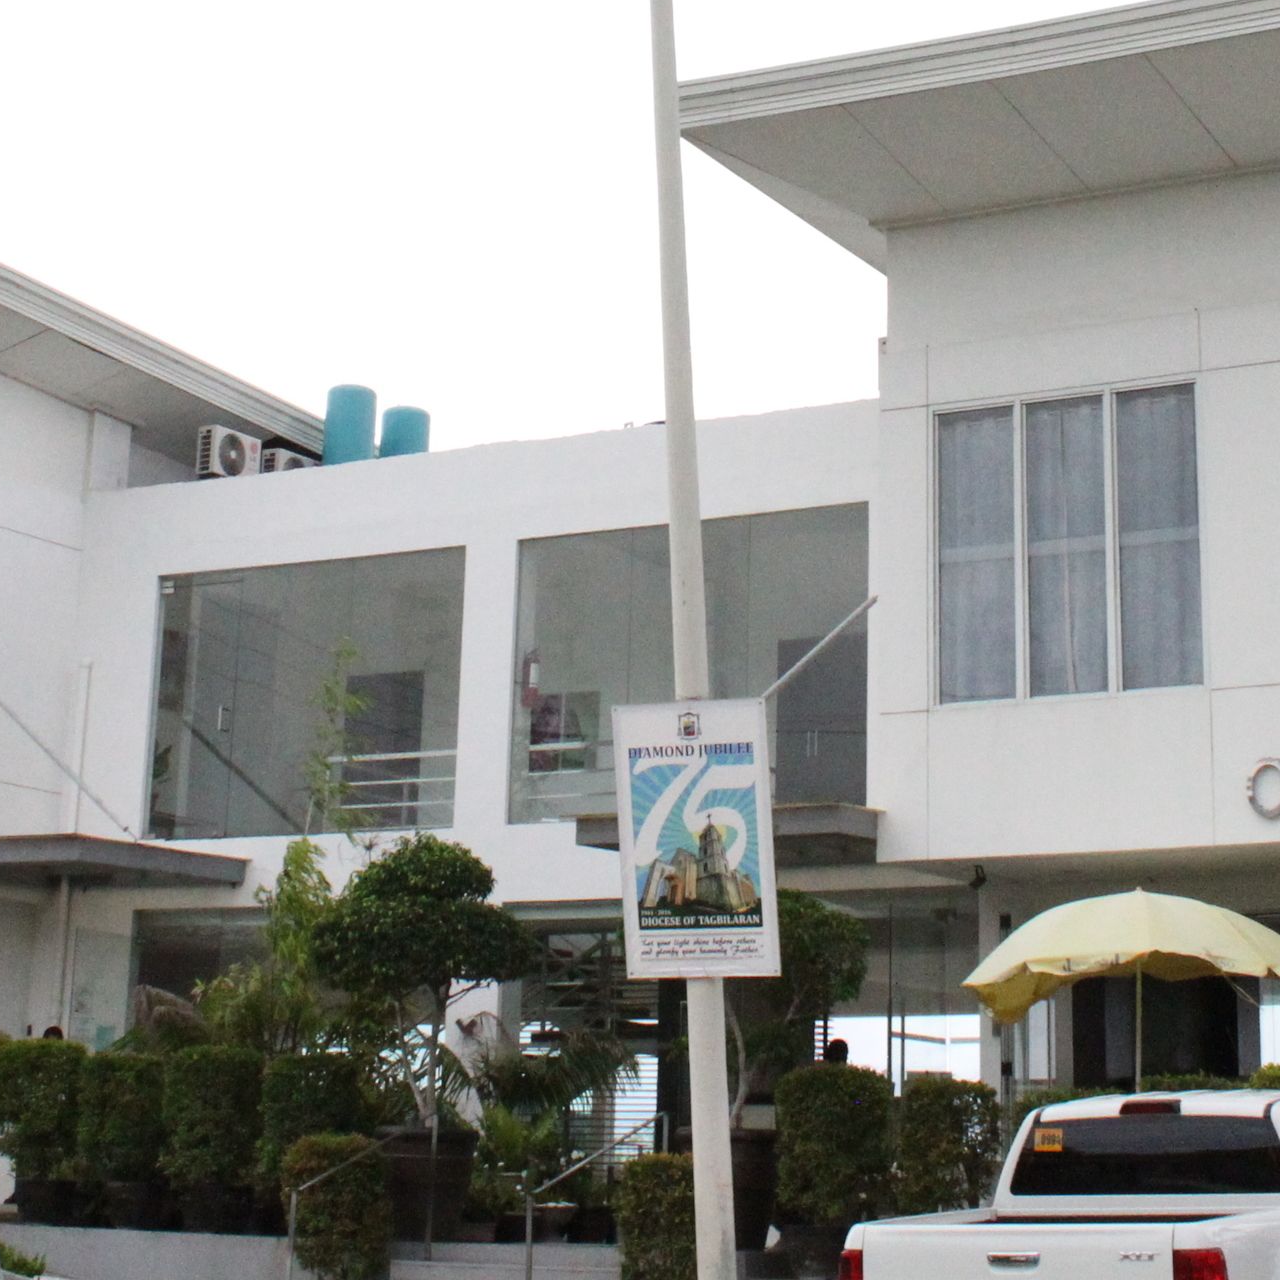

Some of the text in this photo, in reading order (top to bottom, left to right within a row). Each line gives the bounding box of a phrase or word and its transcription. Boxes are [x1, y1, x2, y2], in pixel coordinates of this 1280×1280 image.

[628, 741, 754, 759] DIAMOND JUBILEE
[632, 751, 757, 868] 75
[641, 914, 760, 927] DIOCESE OF TAGBILARAN
